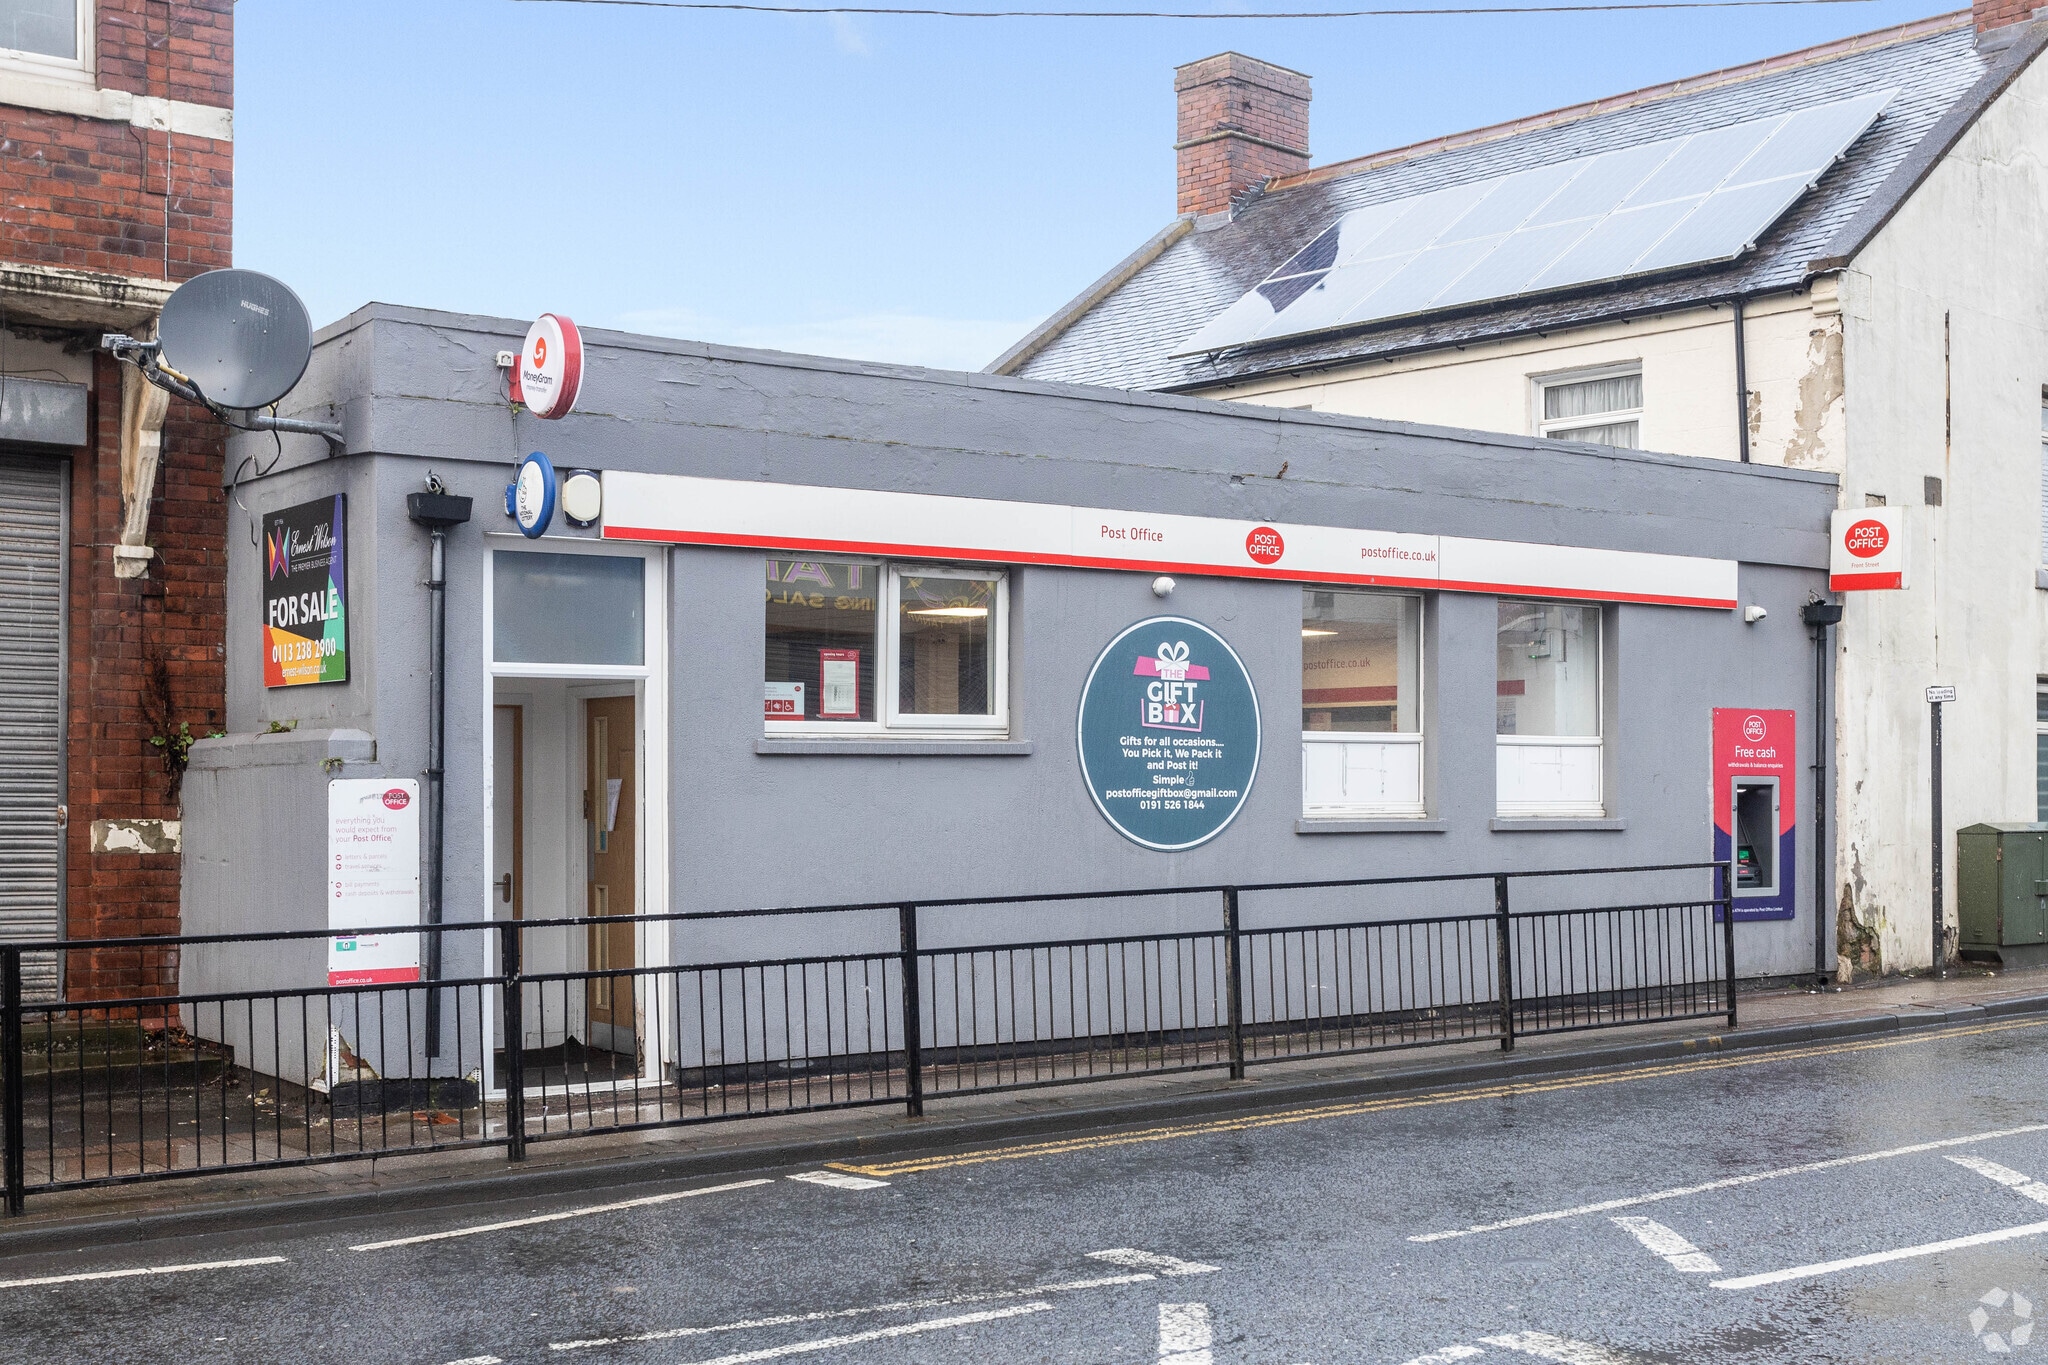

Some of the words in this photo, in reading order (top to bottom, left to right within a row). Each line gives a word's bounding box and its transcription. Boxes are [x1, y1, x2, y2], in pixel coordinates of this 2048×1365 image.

[241, 300, 270, 316] HUGHES
[523, 370, 553, 385] MoneyGram
[1101, 525, 1126, 540] Post
[1130, 527, 1163, 542] Office
[1855, 527, 1881, 538] POST
[291, 530, 315, 557] Ernest
[314, 522, 337, 551] Wilson
[1254, 534, 1277, 545] POST
[1848, 538, 1884, 549] OFFICE
[1249, 544, 1280, 556] OFFICE
[1361, 546, 1437, 562] postoffice.co.uk
[298, 562, 311, 571] PREMIER
[269, 595, 299, 629] FOR
[300, 588, 338, 624] SALE
[272, 643, 293, 663] 0113
[296, 641, 312, 661] 238
[314, 637, 336, 658] 2900
[1303, 657, 1371, 672] postoffice.co.uk
[1163, 669, 1183, 679] THE
[1147, 681, 1198, 702] GIFT
[1120, 736, 1142, 746] Gifts
[1144, 736, 1157, 746] for
[1159, 736, 1170, 746] all
[1122, 749, 1139, 758] You
[1142, 748, 1161, 758] Pick
[1164, 749, 1173, 759] it,
[1175, 749, 1189, 758] We
[1191, 749, 1213, 758] Pack
[1215, 749, 1222, 758] it
[1735, 745, 1754, 757] Free
[1756, 746, 1776, 758] cash
[1147, 761, 1164, 770] and
[1167, 761, 1187, 770] Post
[1189, 761, 1198, 770] it!
[1153, 775, 1185, 786] Simple
[1106, 788, 1238, 800] postofficegiftbox@gmail.com
[1140, 800, 1161, 810] 0191
[1164, 800, 1181, 810] 526
[1184, 801, 1205, 810] 1844
[358, 827, 379, 835] expect
[353, 834, 368, 842] Post
[371, 834, 392, 842] Office
[336, 977, 373, 985] postoffice.co.uk
